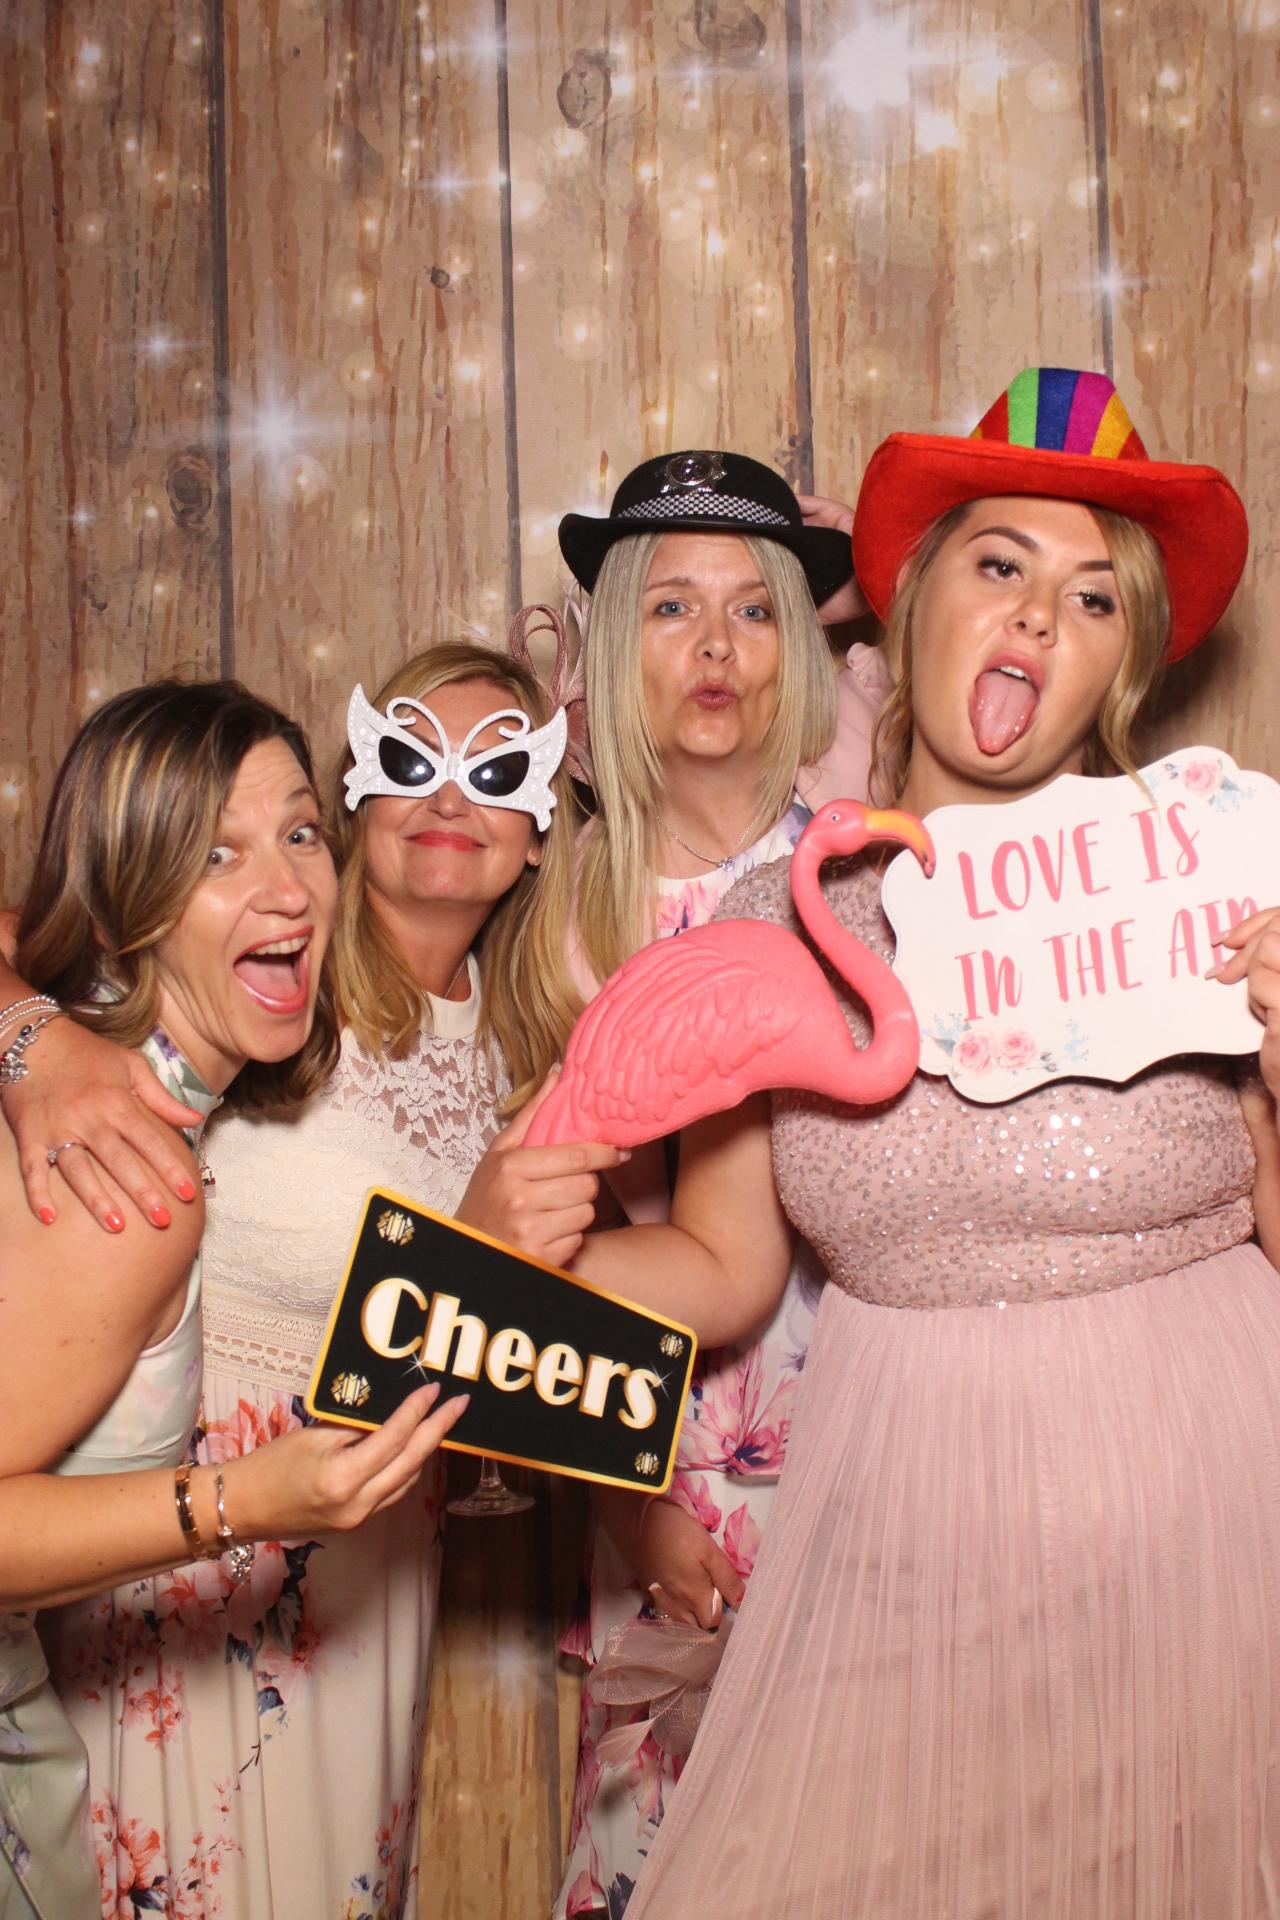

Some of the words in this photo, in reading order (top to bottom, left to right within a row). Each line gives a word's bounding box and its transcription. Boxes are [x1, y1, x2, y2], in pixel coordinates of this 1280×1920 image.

[958, 820, 1110, 920] LOVE
[1130, 802, 1199, 884] IS
[1043, 918, 1142, 1002] THE
[361, 1277, 660, 1430] Cheers
